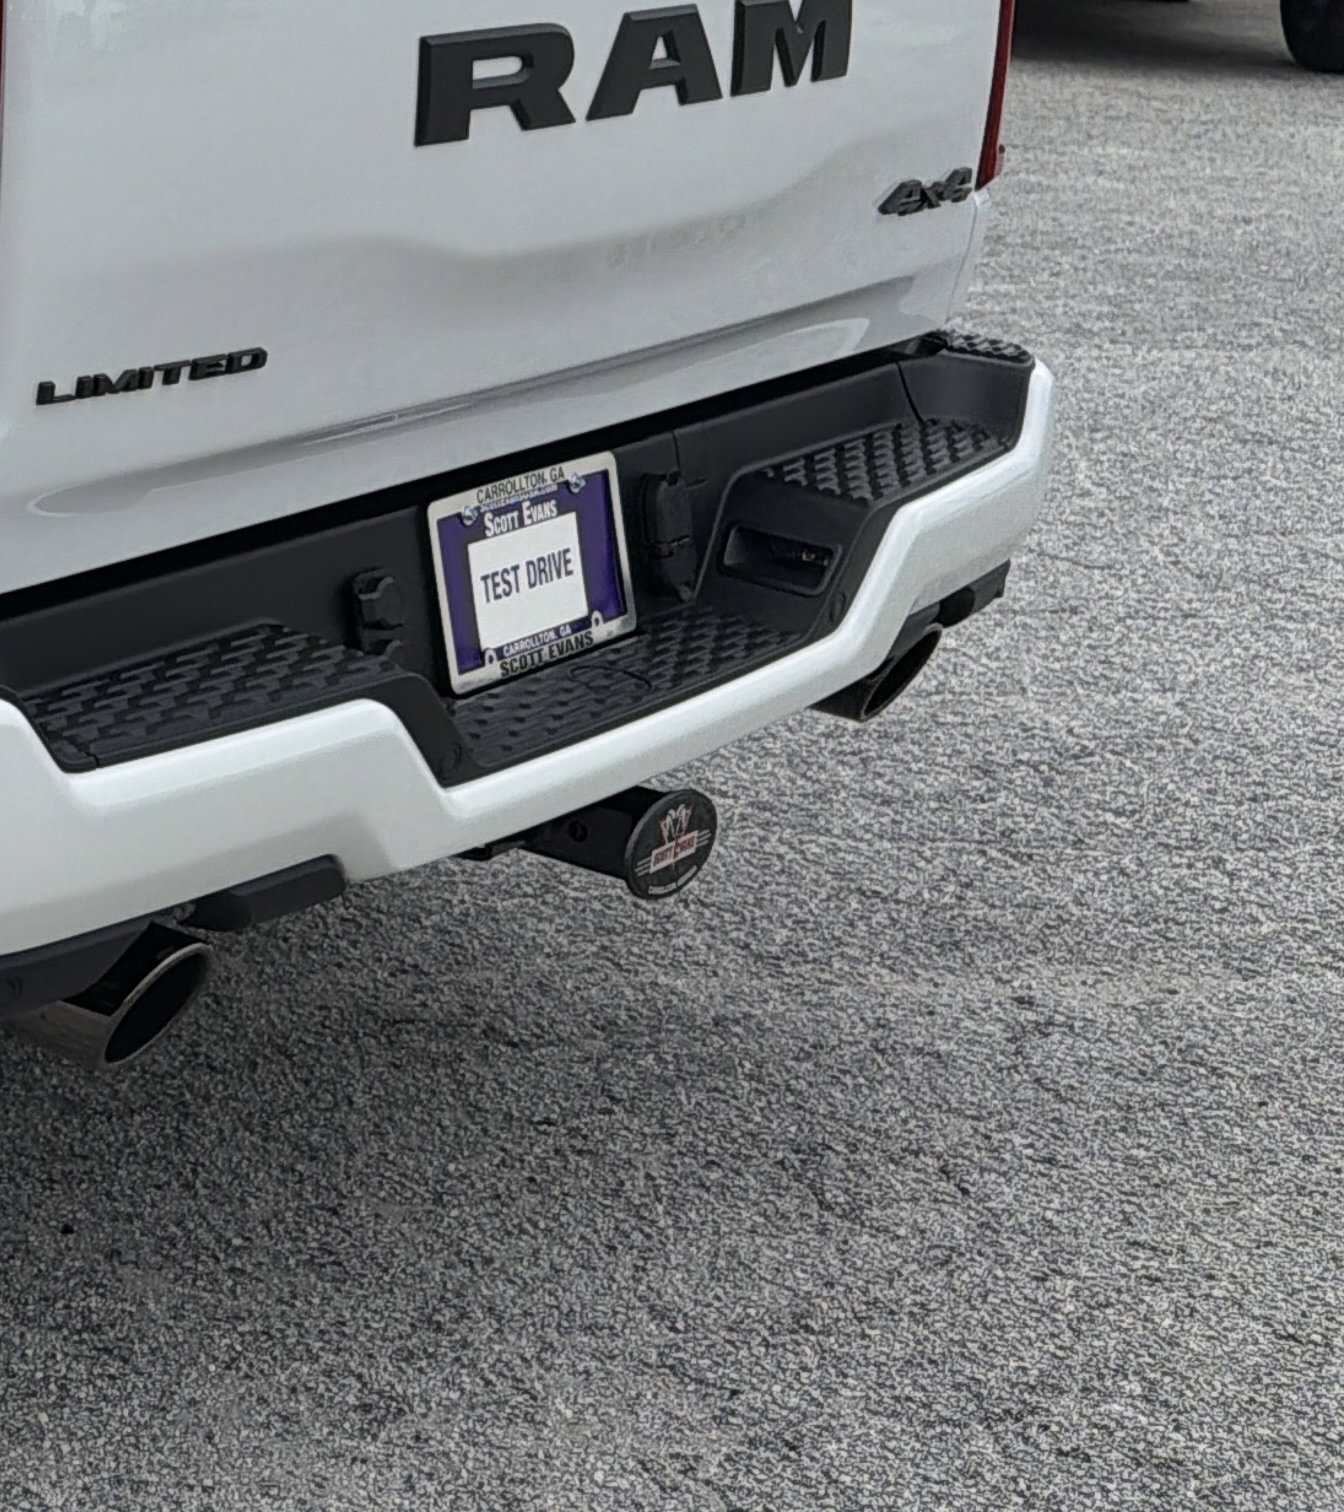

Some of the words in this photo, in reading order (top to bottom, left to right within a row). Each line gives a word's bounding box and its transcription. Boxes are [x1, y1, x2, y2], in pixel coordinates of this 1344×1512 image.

[36, 347, 268, 405] LIMITED
[549, 467, 566, 483] GA
[480, 564, 521, 603] TEST
[525, 548, 574, 589] DRIVE
[499, 647, 544, 677] SCOTT
[548, 630, 594, 658] EVANS
